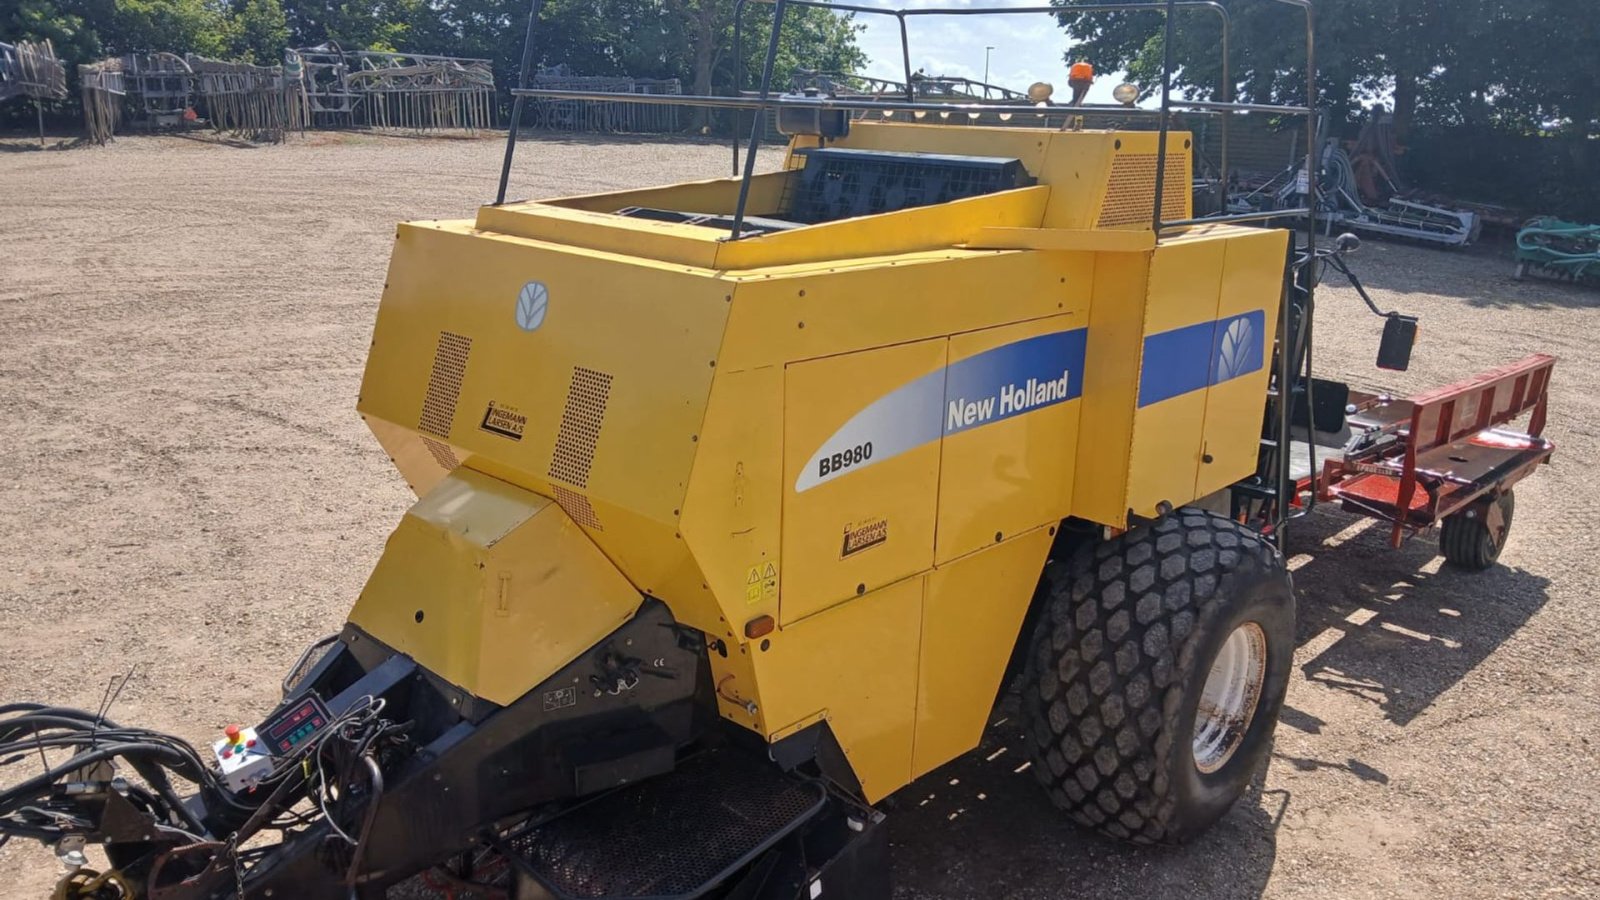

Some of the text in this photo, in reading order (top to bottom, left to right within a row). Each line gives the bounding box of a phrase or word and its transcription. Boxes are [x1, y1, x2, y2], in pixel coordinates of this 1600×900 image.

[948, 370, 1068, 430] New Holland
[819, 441, 872, 477] BB980
